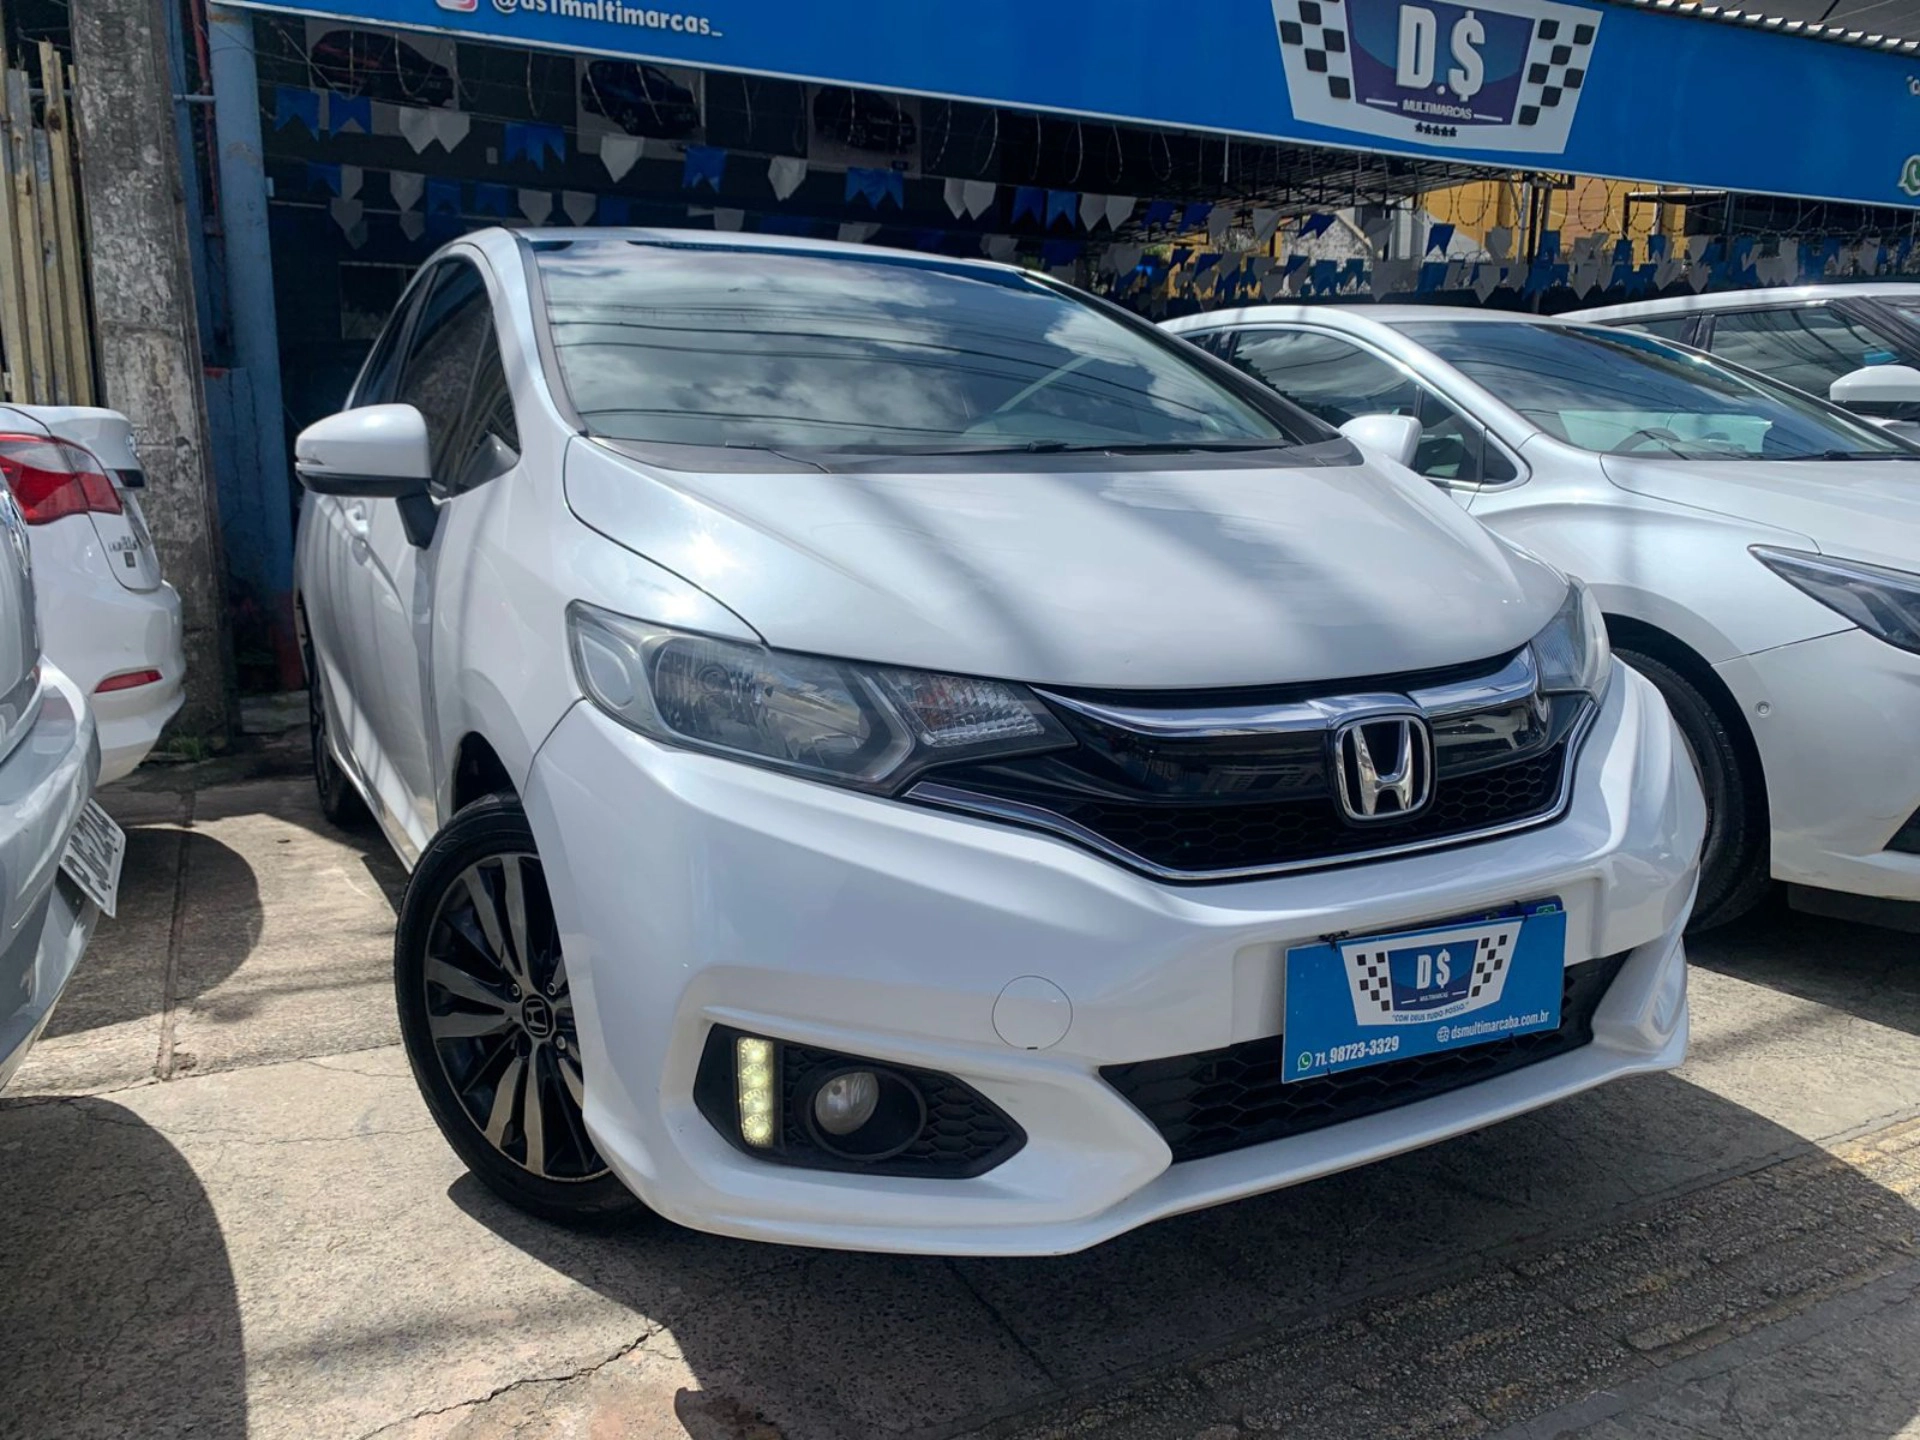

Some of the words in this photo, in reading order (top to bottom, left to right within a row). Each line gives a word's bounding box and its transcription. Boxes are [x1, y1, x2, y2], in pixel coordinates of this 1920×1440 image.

[1402, 99, 1472, 120] MULTIMARCAS
[1451, 1011, 1549, 1040] dsmultimarcaba.com.br
[1329, 1035, 1400, 1064] 98723-3329
